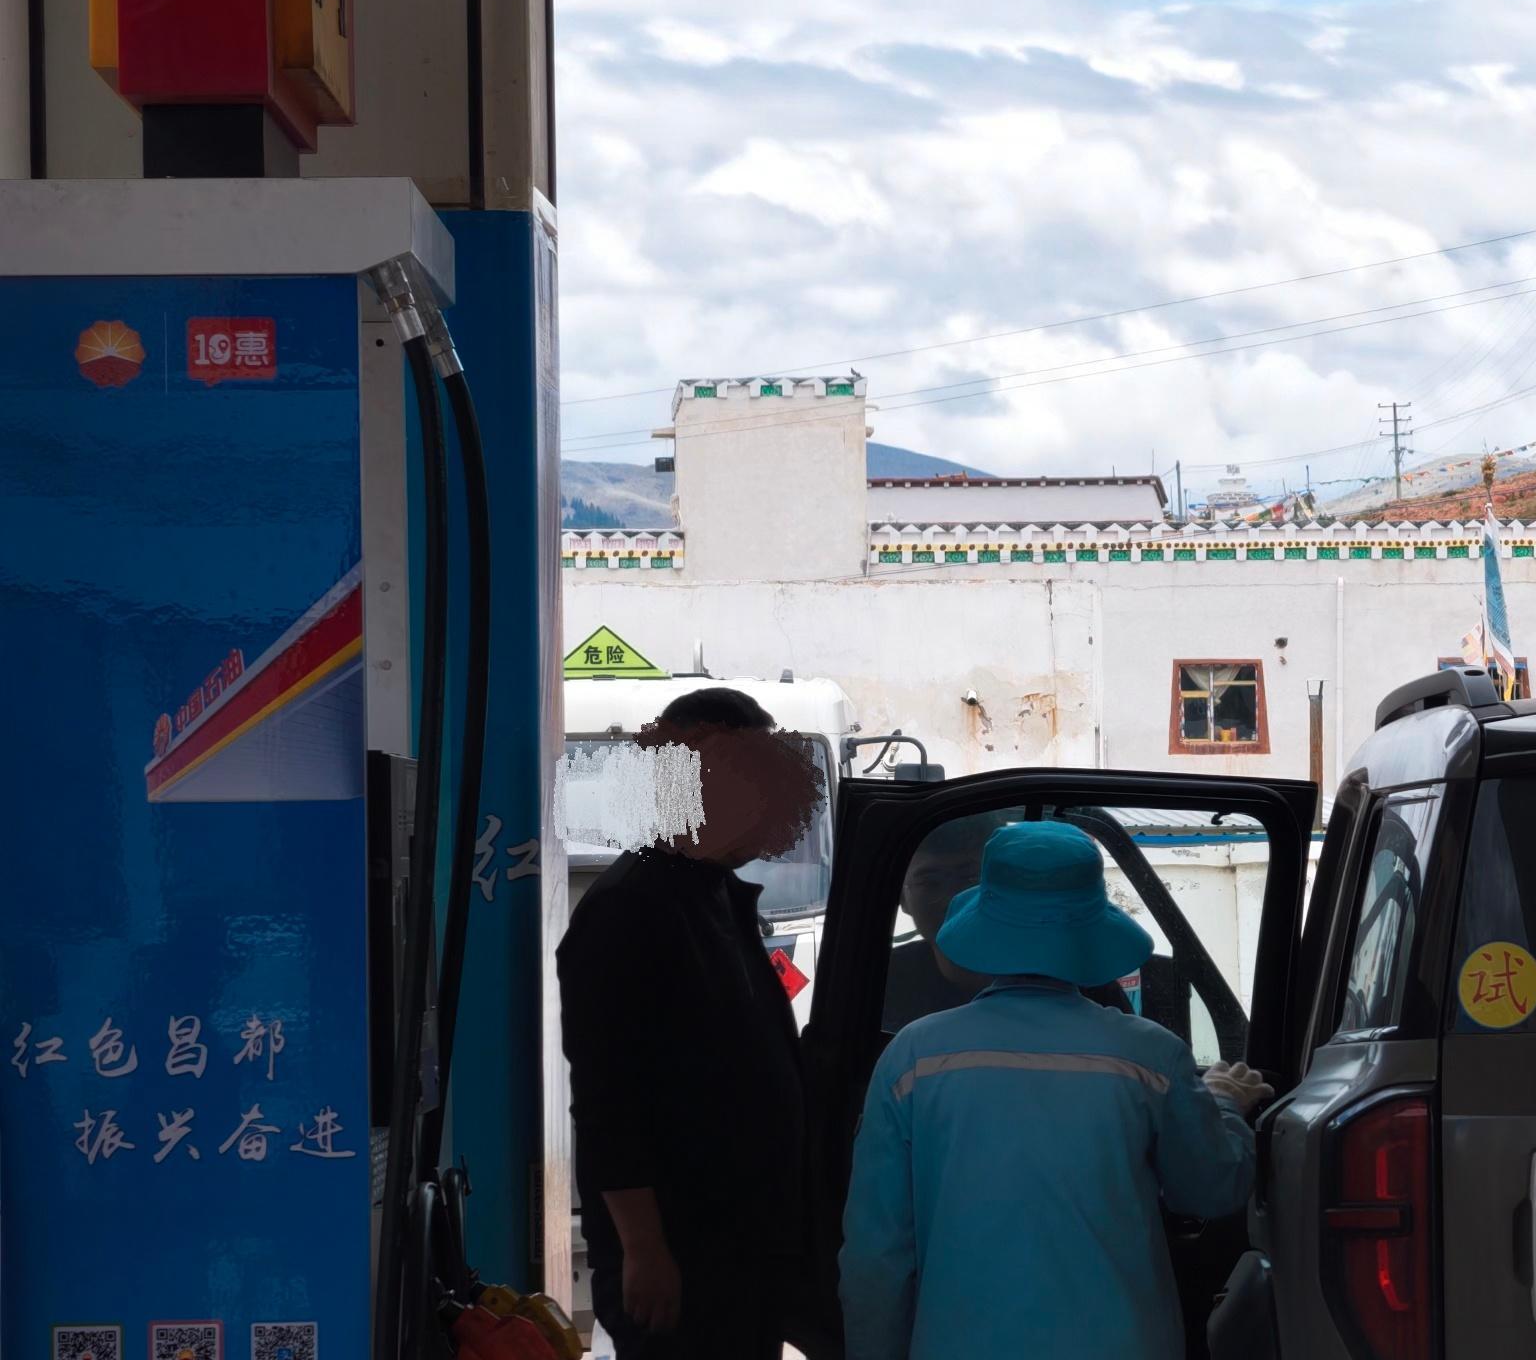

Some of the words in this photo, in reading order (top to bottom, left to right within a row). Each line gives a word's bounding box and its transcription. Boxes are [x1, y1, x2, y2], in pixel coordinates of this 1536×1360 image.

[583, 645, 626, 666] 危险
[172, 647, 246, 732] 中国石油
[1467, 949, 1528, 1015] 试
[11, 1014, 286, 1080] 红色昌都
[73, 1103, 358, 1165] 振兴奋进
